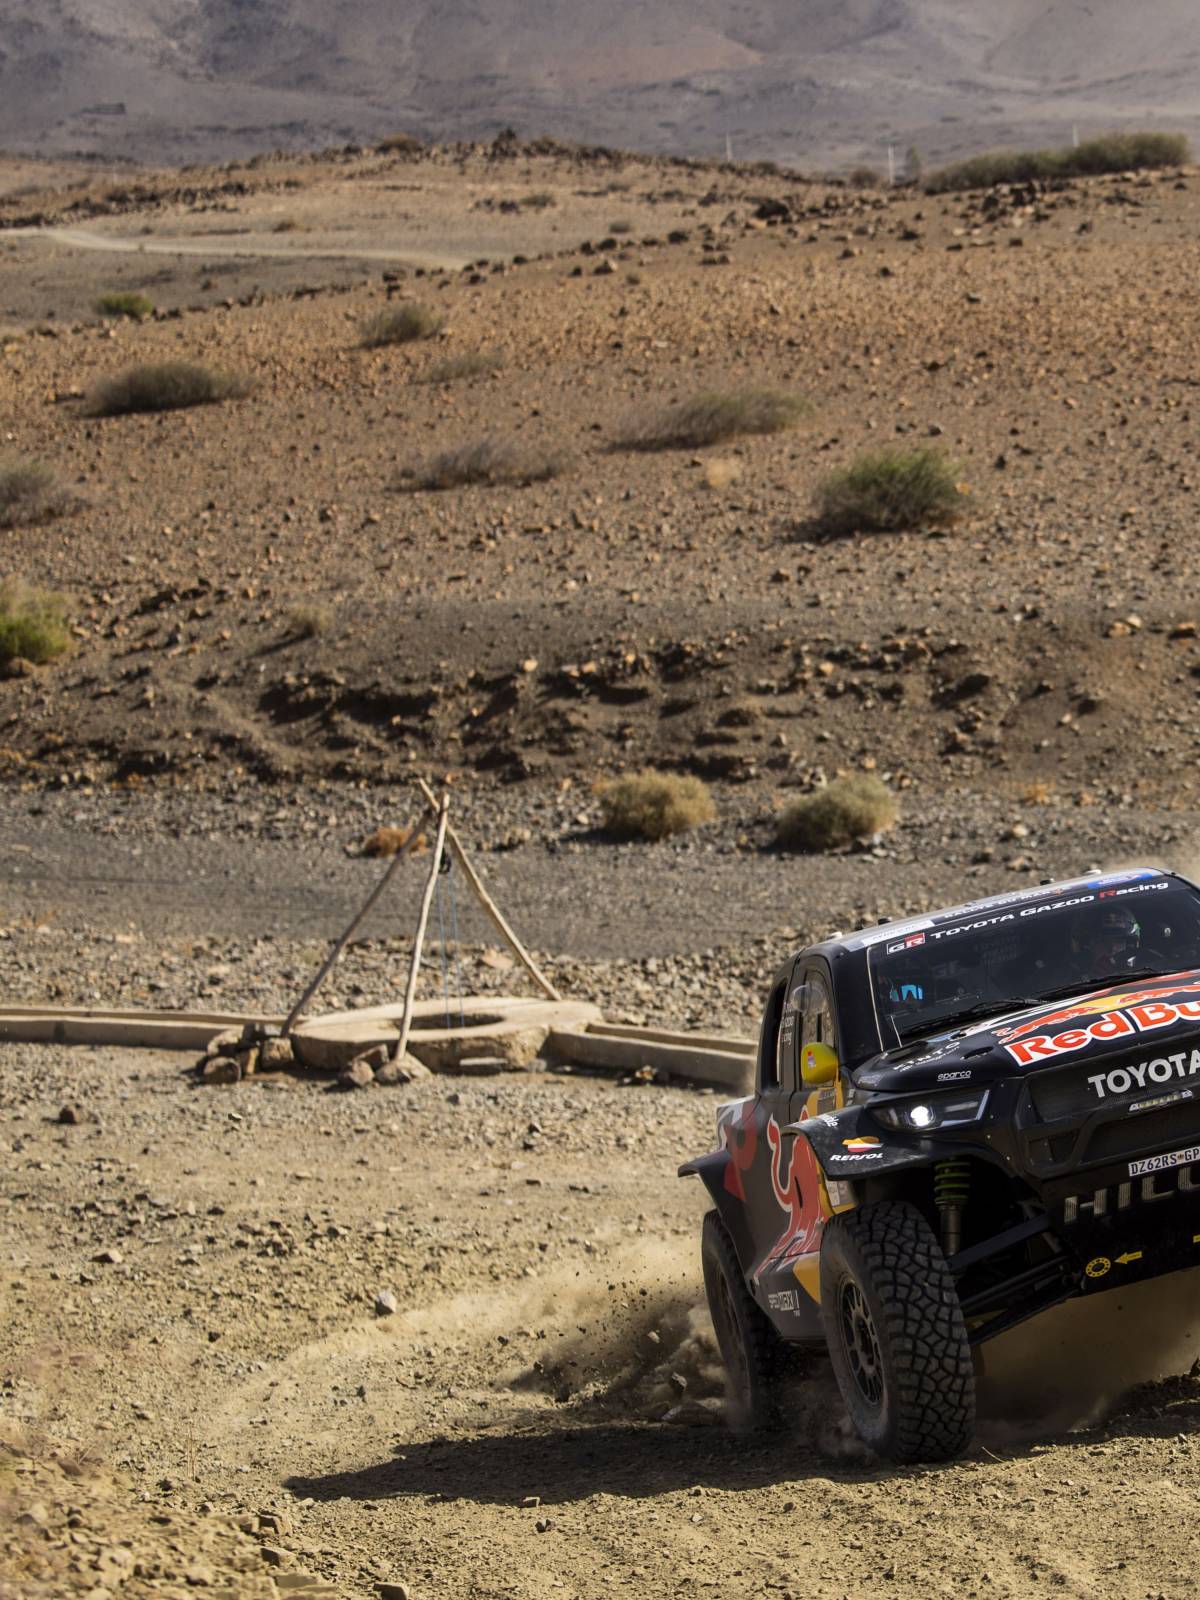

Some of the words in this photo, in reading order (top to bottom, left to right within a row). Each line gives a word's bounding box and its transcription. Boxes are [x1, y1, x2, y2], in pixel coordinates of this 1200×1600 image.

[888, 934, 924, 954] GR
[930, 914, 1015, 940] TOYOTA
[1020, 895, 1095, 918] GAZOO
[1099, 882, 1169, 899] Racing
[1005, 1011, 1134, 1066] Red
[937, 1070, 972, 1082] sparco
[830, 1153, 883, 1161] REPSOL
[1130, 1153, 1177, 1175] DZ62RS
[1184, 1148, 1200, 1161] GP
